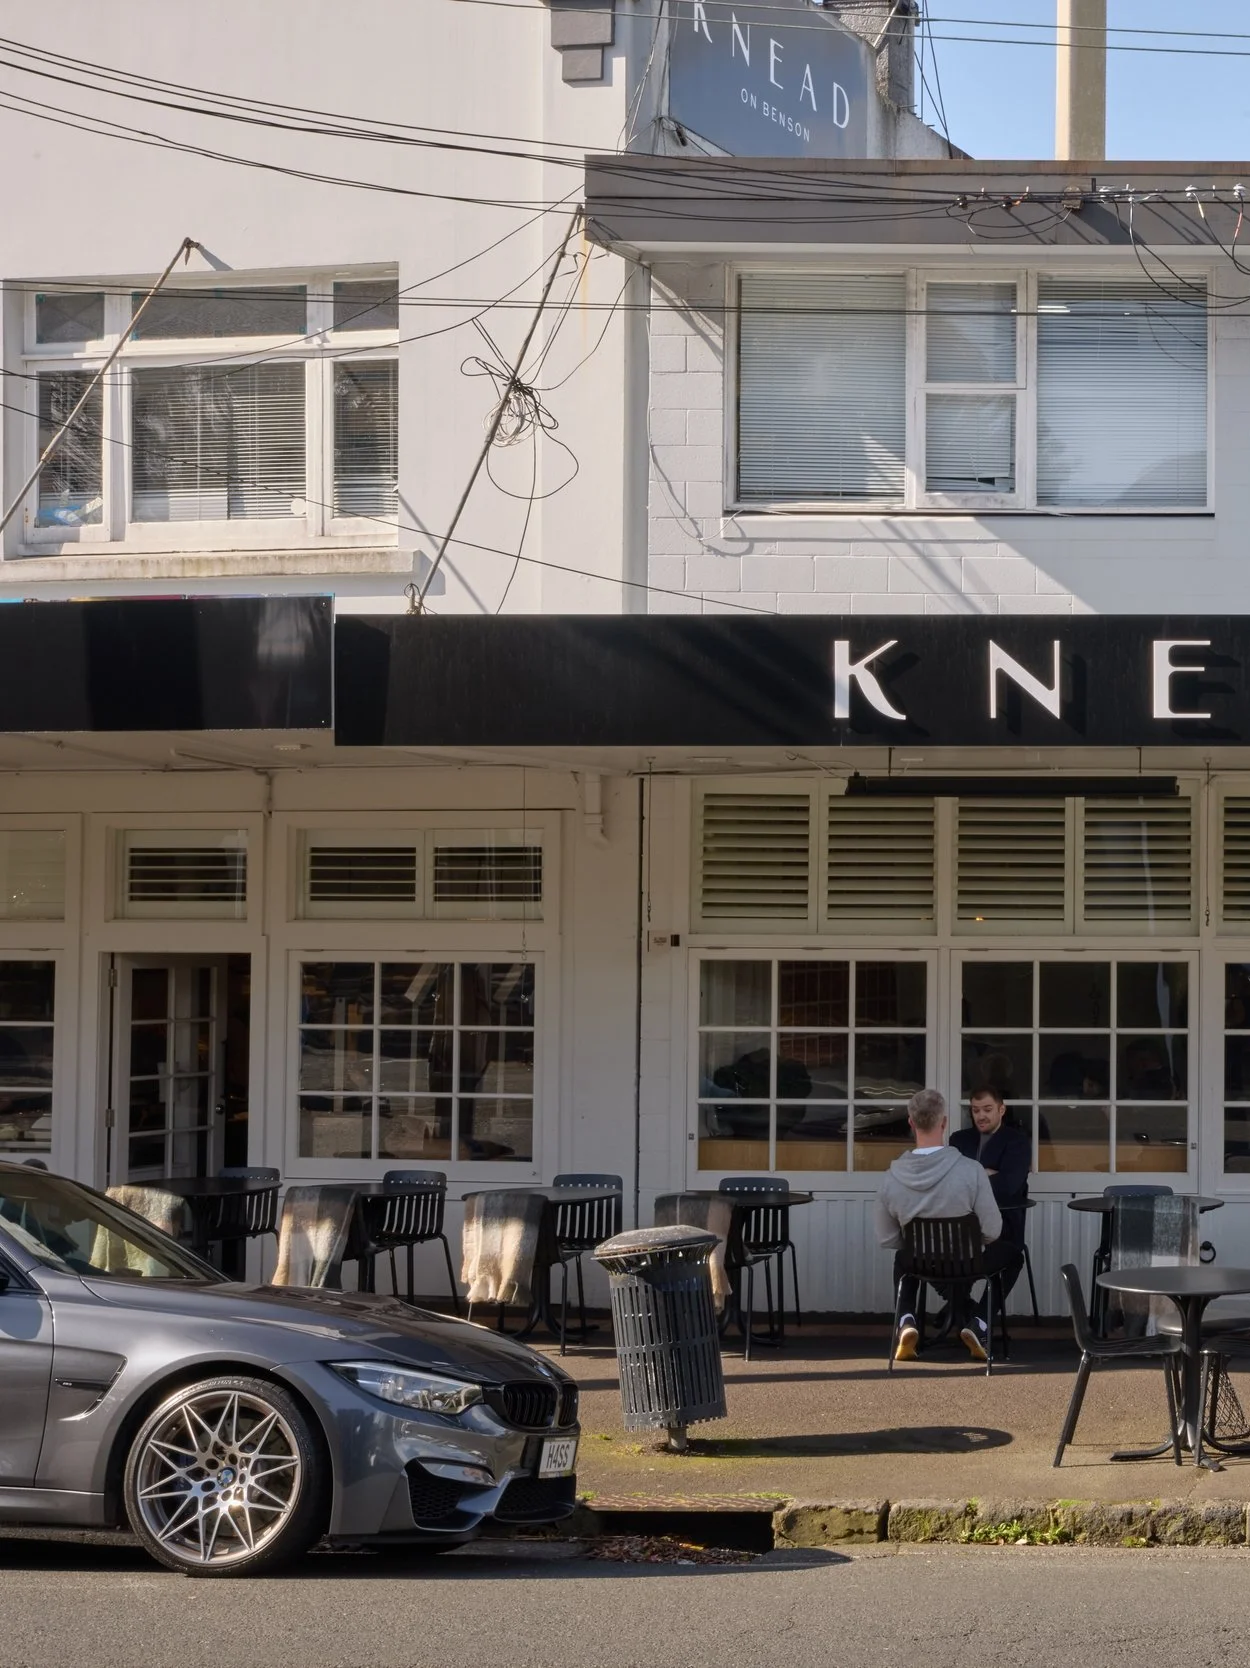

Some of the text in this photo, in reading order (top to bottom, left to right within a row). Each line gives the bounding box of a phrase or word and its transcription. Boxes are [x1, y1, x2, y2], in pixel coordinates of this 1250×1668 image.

[694, 0, 849, 128] KNEAD
[740, 88, 810, 142] ON BENSON
[546, 1444, 570, 1469] H4SS
